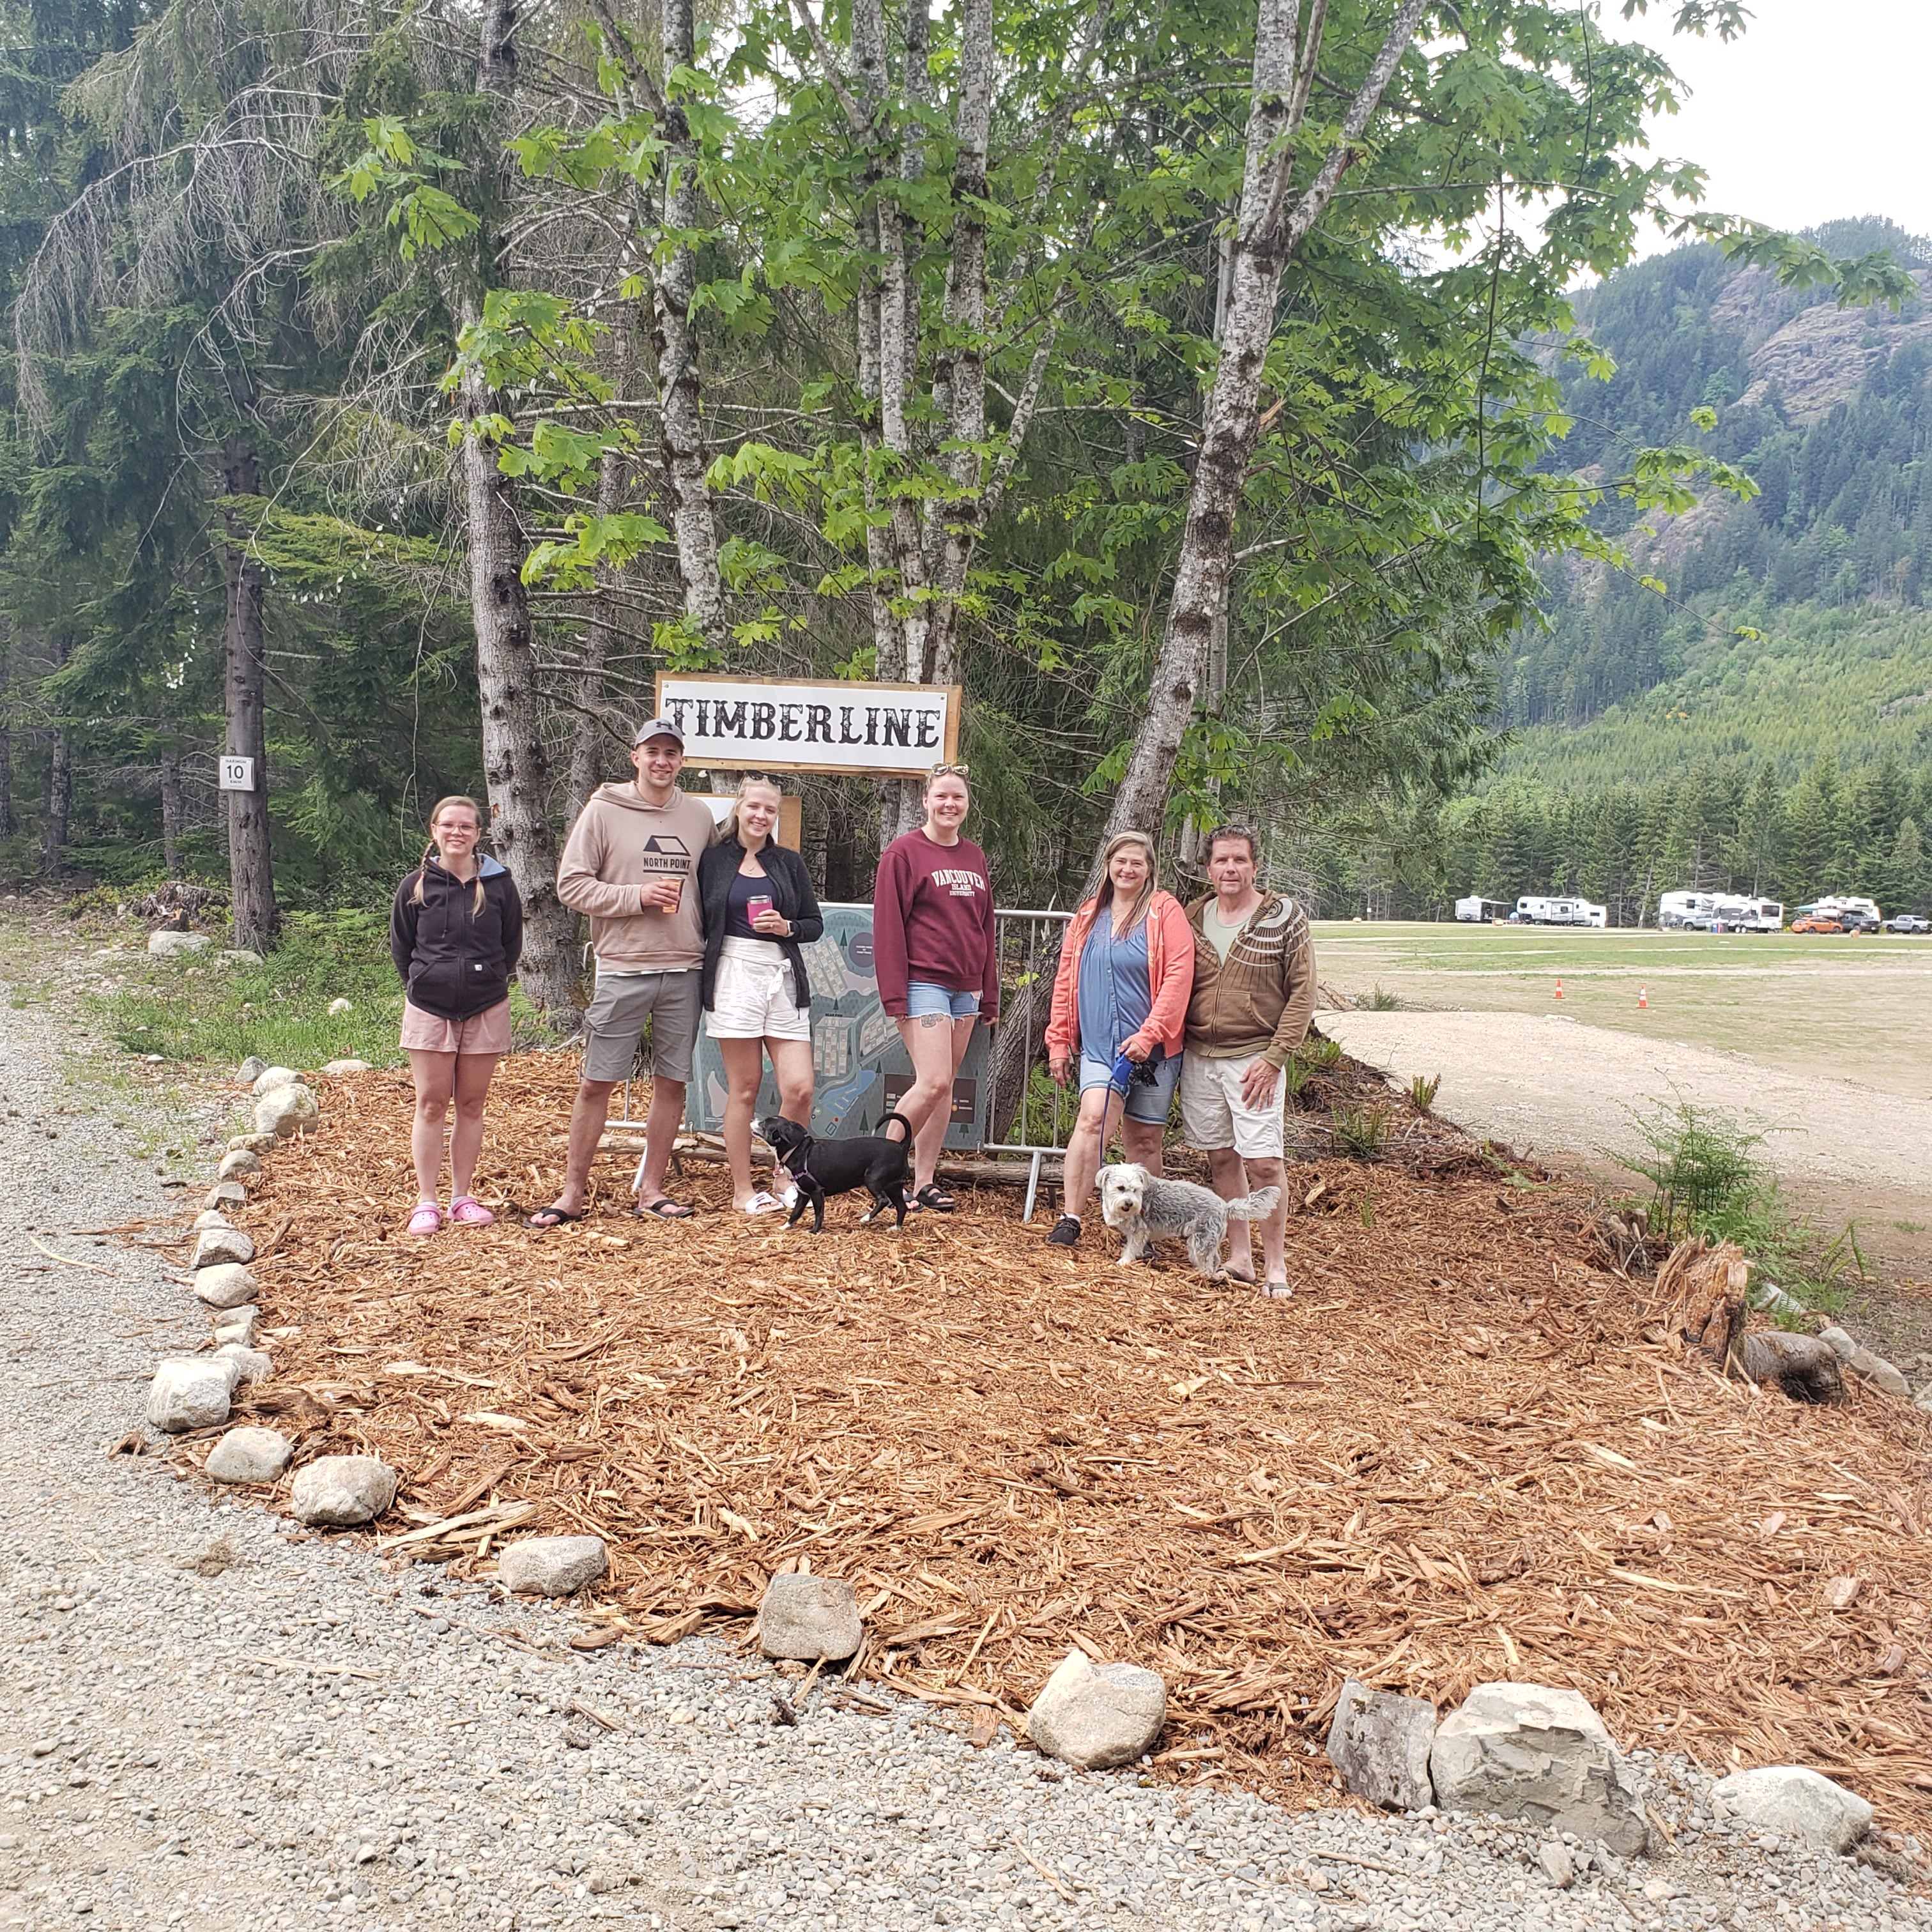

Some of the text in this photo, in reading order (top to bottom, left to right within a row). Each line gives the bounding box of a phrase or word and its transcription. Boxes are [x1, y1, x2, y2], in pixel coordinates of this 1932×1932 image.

[665, 698, 941, 748] TIMBERLINE
[227, 765, 244, 779] 10
[643, 857, 692, 870] NORTH POINT
[931, 869, 986, 892] VANCOUVER
